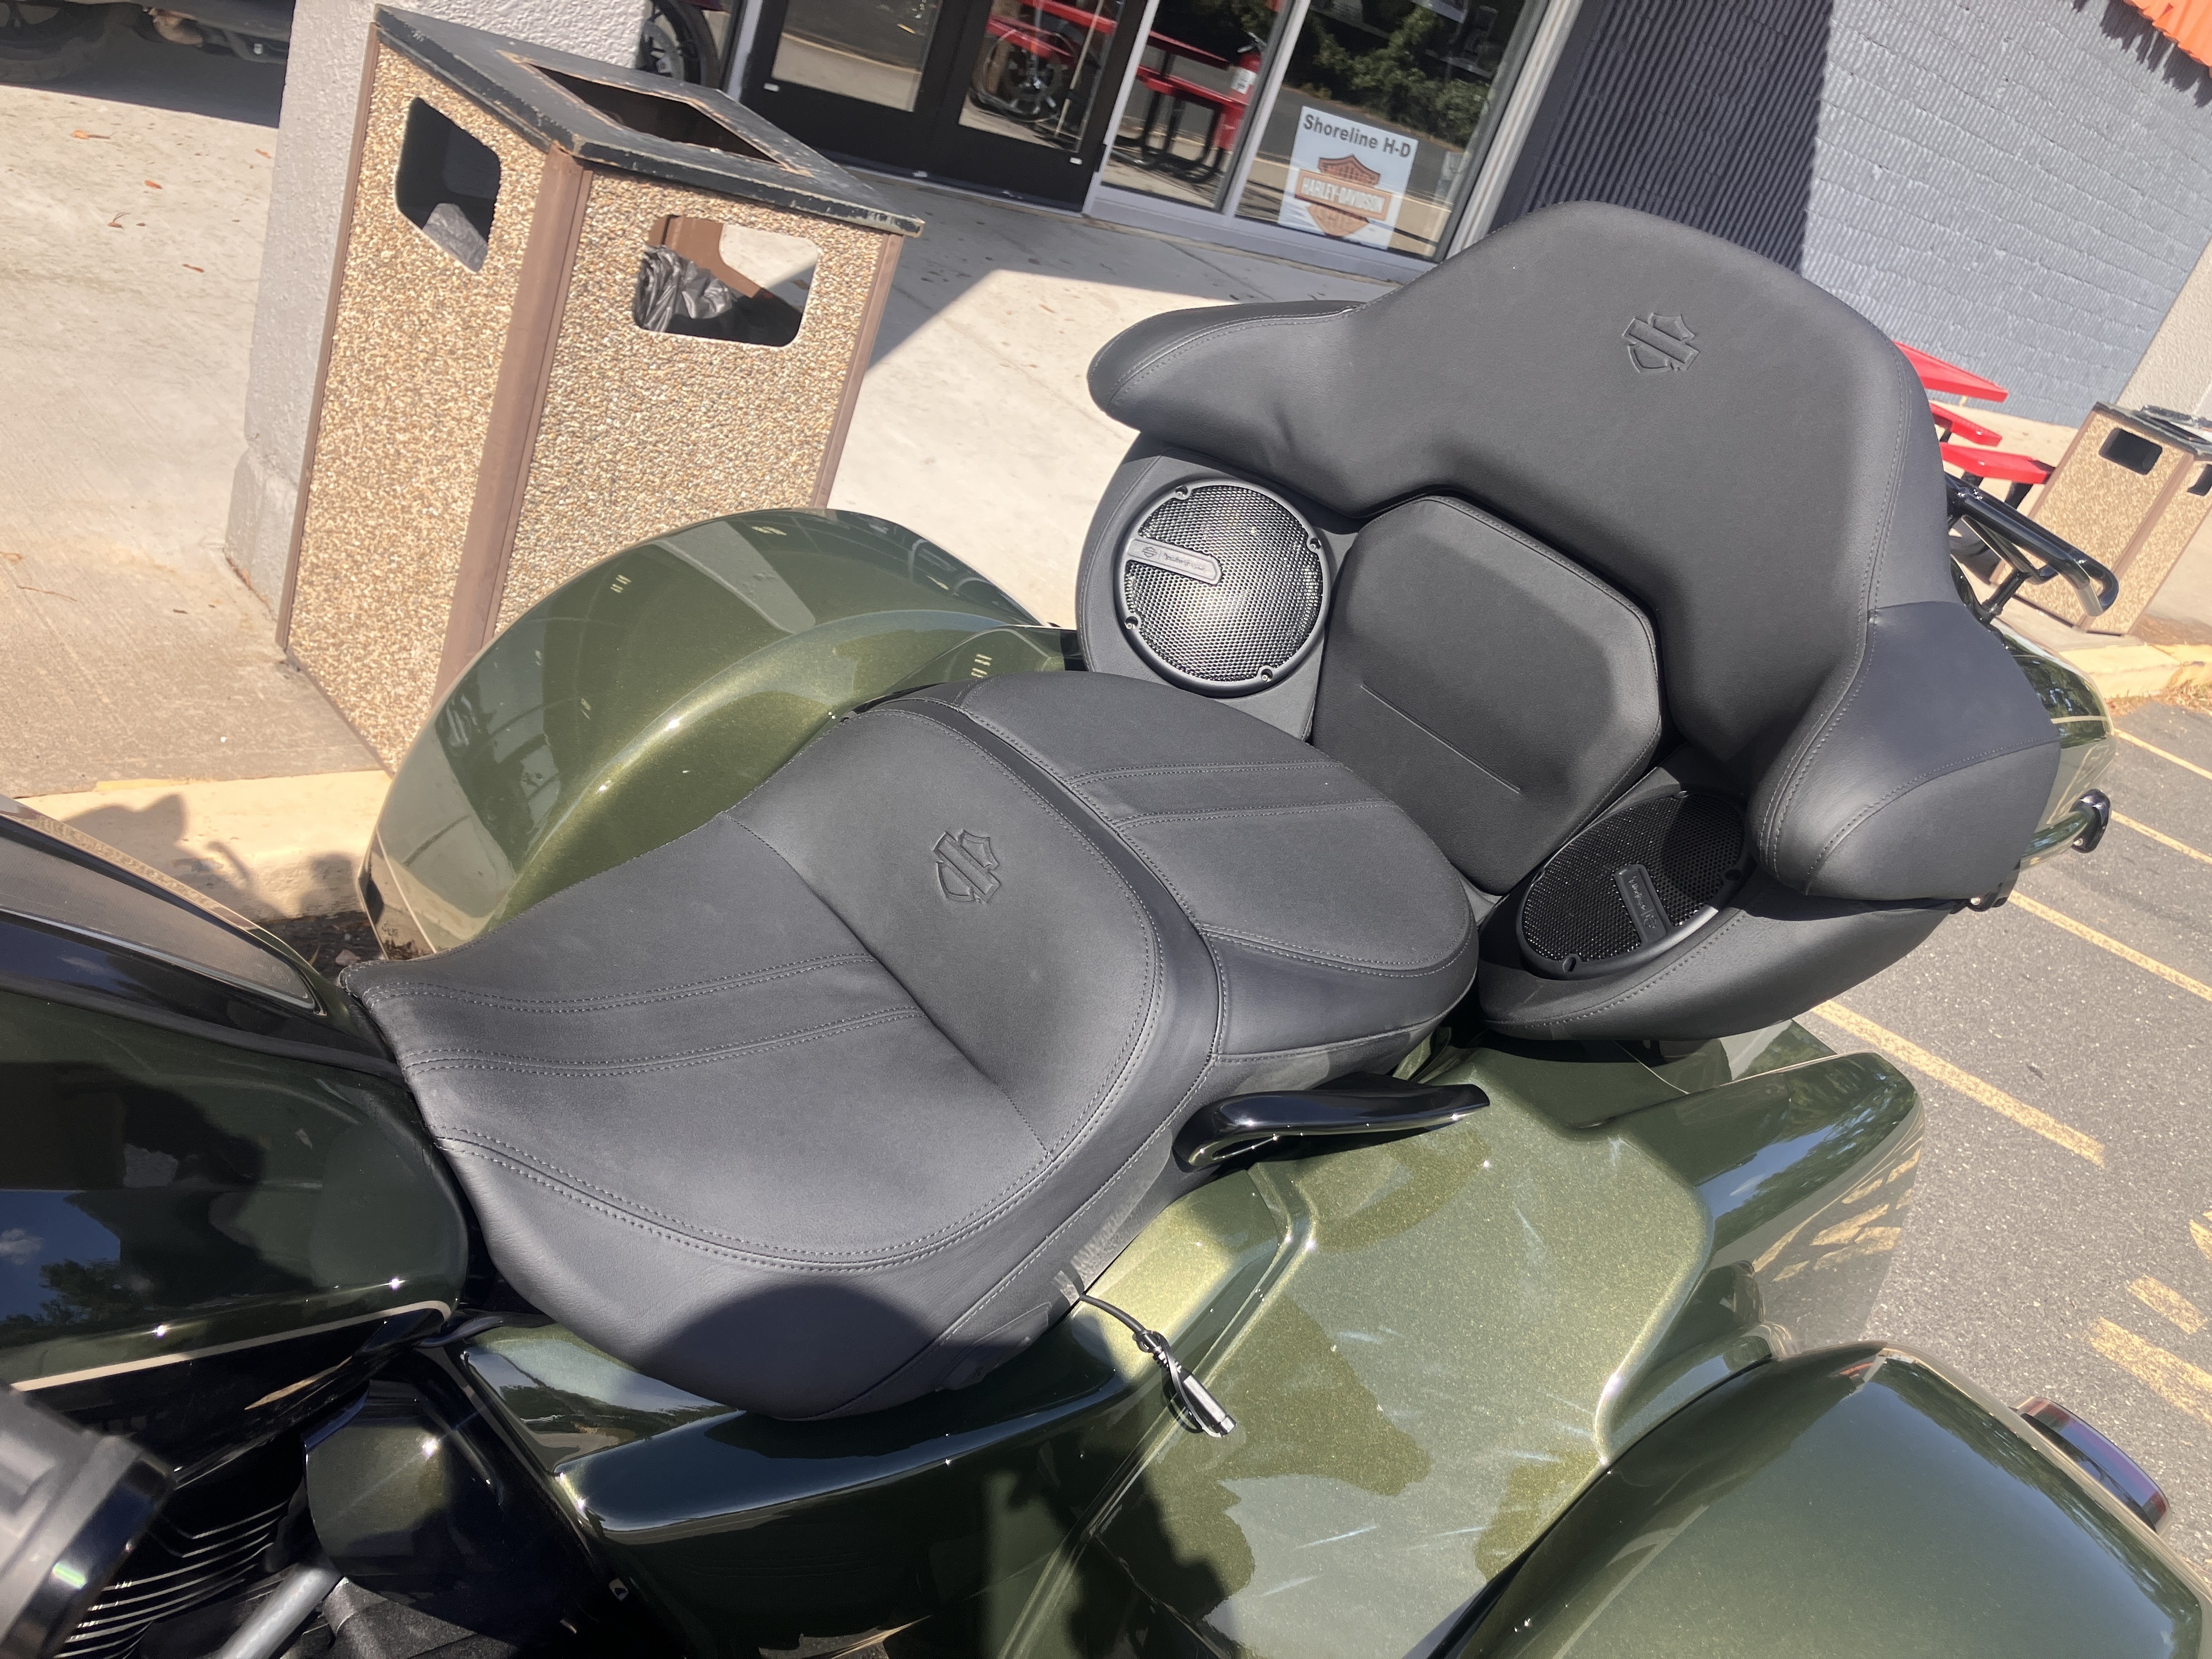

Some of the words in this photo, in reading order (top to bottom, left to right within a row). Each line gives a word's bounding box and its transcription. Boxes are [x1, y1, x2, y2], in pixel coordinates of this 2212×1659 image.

[1303, 114, 1378, 149] Shoreline
[1382, 137, 1410, 157] H-D
[1301, 178, 1386, 213] HARLEY-DAVIDSON
